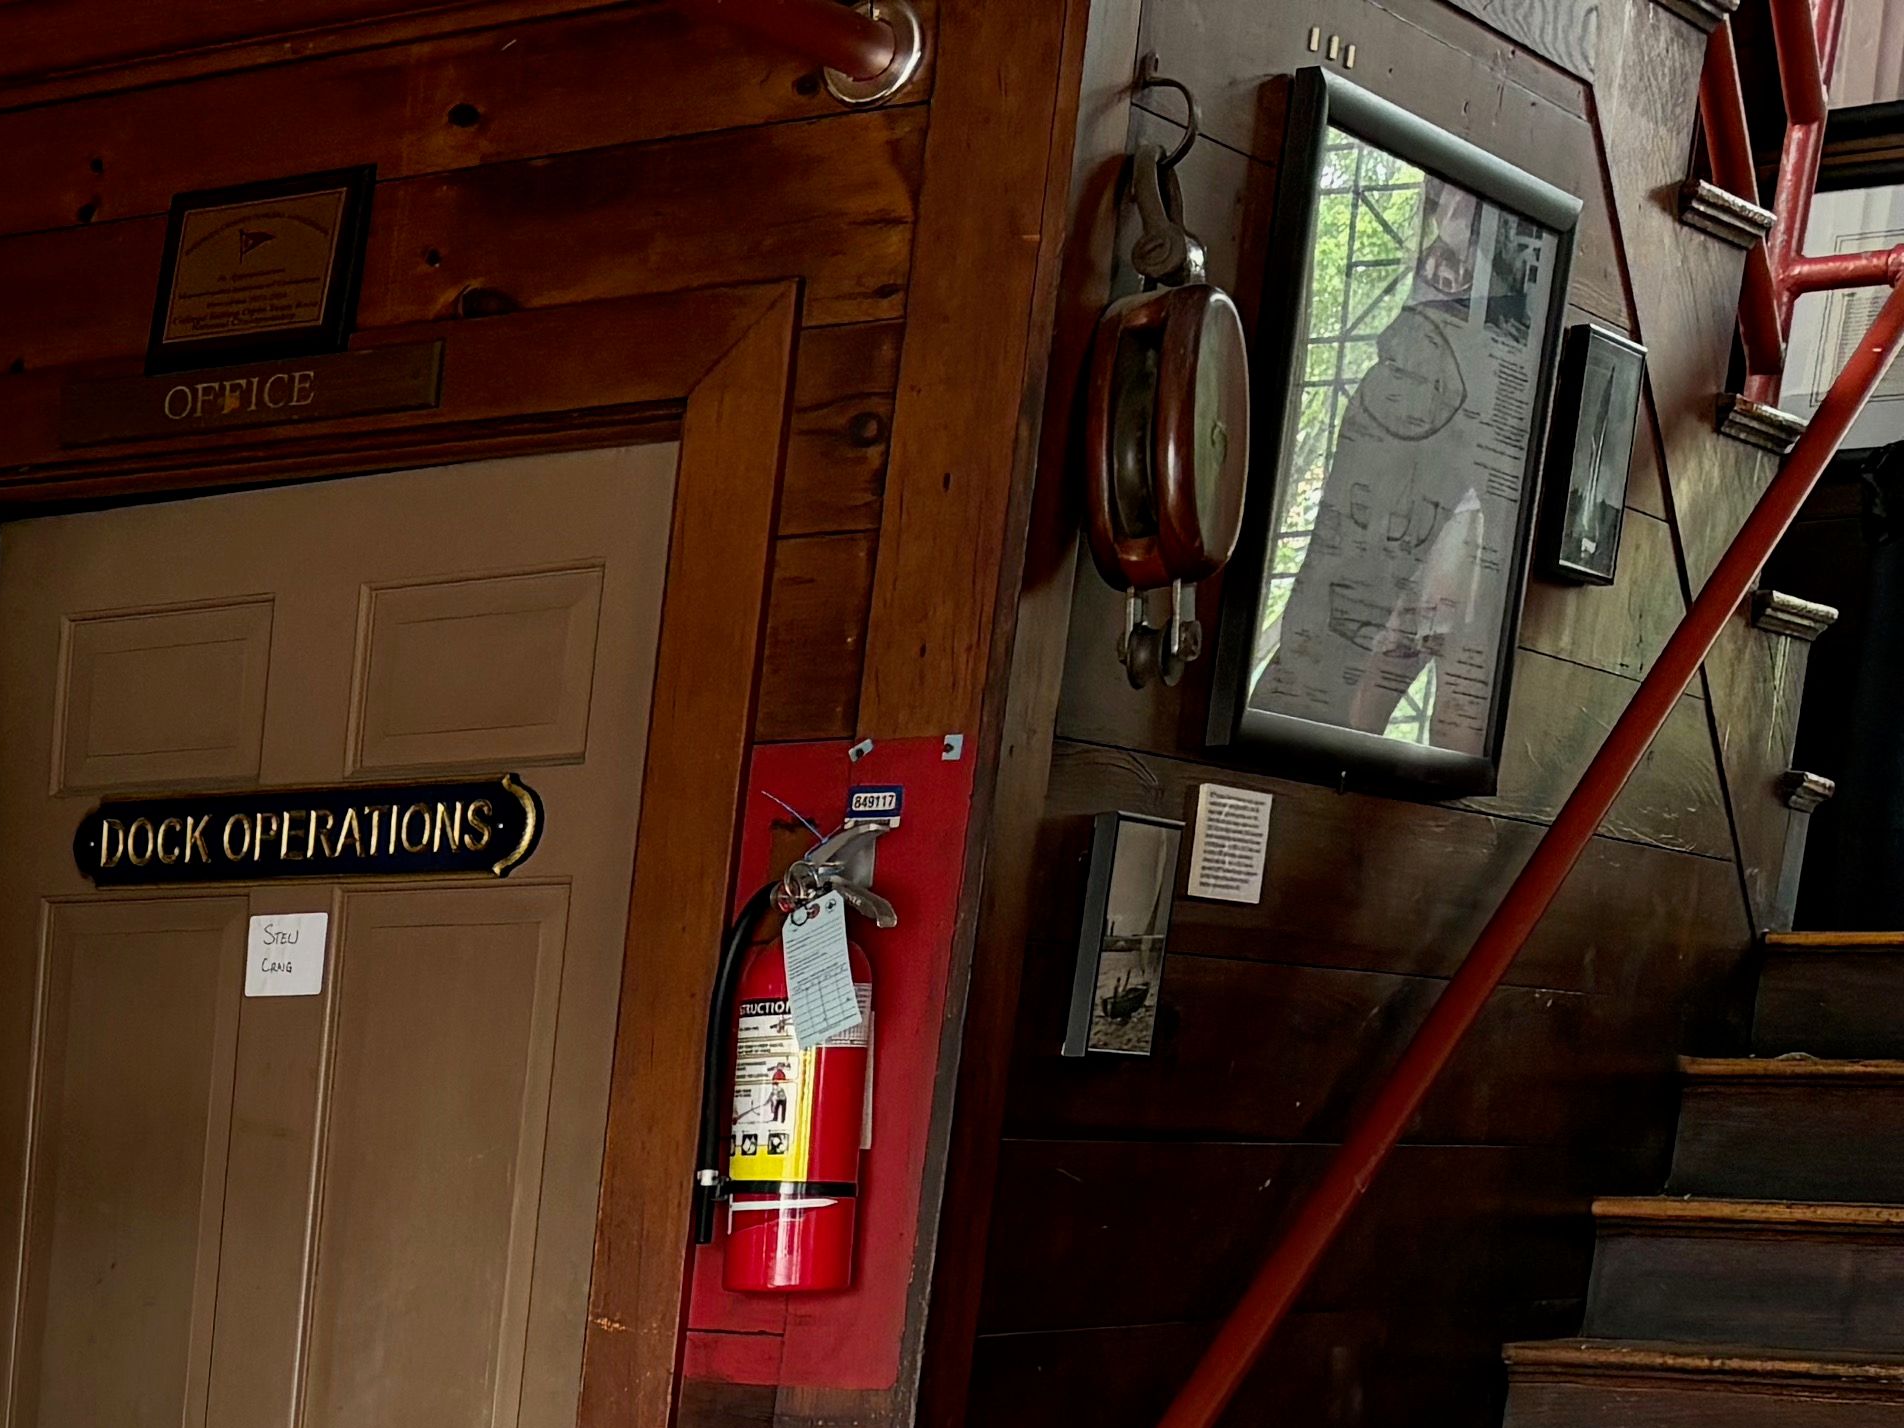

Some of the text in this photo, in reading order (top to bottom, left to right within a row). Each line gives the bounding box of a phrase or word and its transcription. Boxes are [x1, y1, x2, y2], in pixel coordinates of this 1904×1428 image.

[164, 371, 316, 420] OFFICE
[853, 794, 895, 809] 849117
[100, 798, 493, 868] DOCK OPERATIONS
